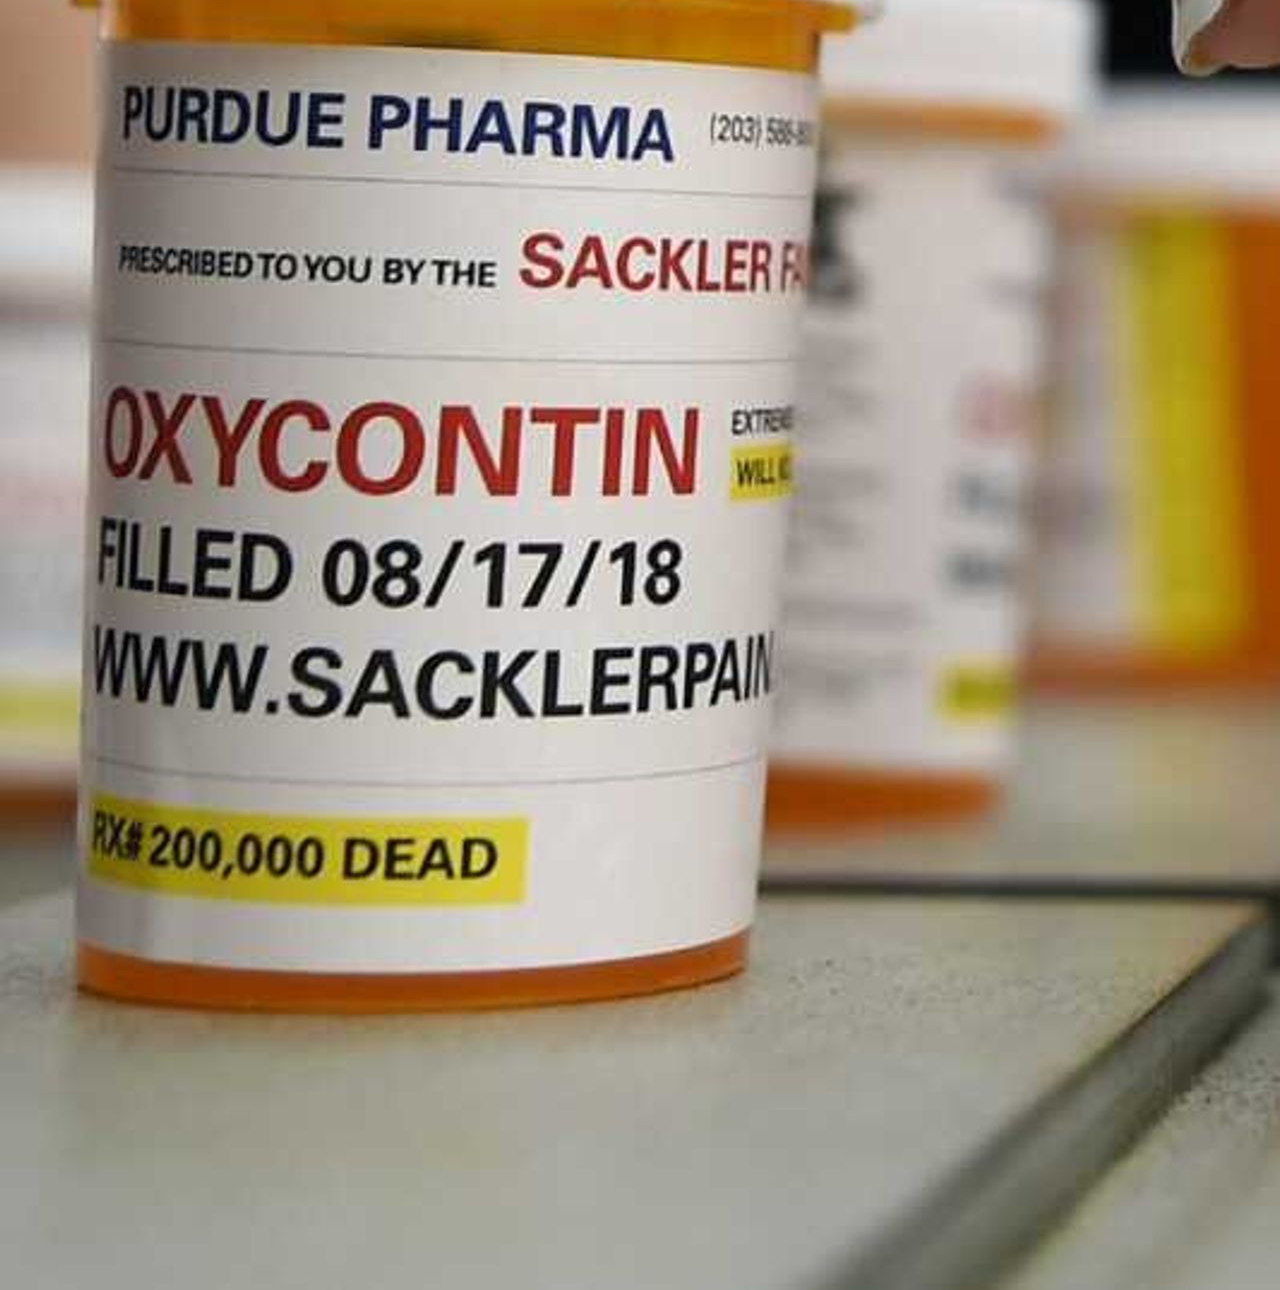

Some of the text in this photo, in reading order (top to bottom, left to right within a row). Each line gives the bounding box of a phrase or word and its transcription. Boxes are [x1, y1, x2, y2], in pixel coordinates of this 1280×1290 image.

[123, 85, 345, 147] PURDUE
[368, 94, 675, 162] PHARMA
[710, 111, 762, 147] (203)
[117, 244, 253, 278] PRESCRIBED
[257, 252, 298, 281] TO
[302, 253, 373, 284] YOU
[382, 257, 427, 285] BY
[430, 259, 499, 288] THE
[518, 232, 773, 293] SACKLER
[103, 385, 701, 498] OXYCONTIN
[736, 457, 777, 488] WILL
[98, 516, 683, 610] FILLED 08/17/18
[149, 823, 325, 883] 200,000
[343, 837, 499, 881] DEAD
